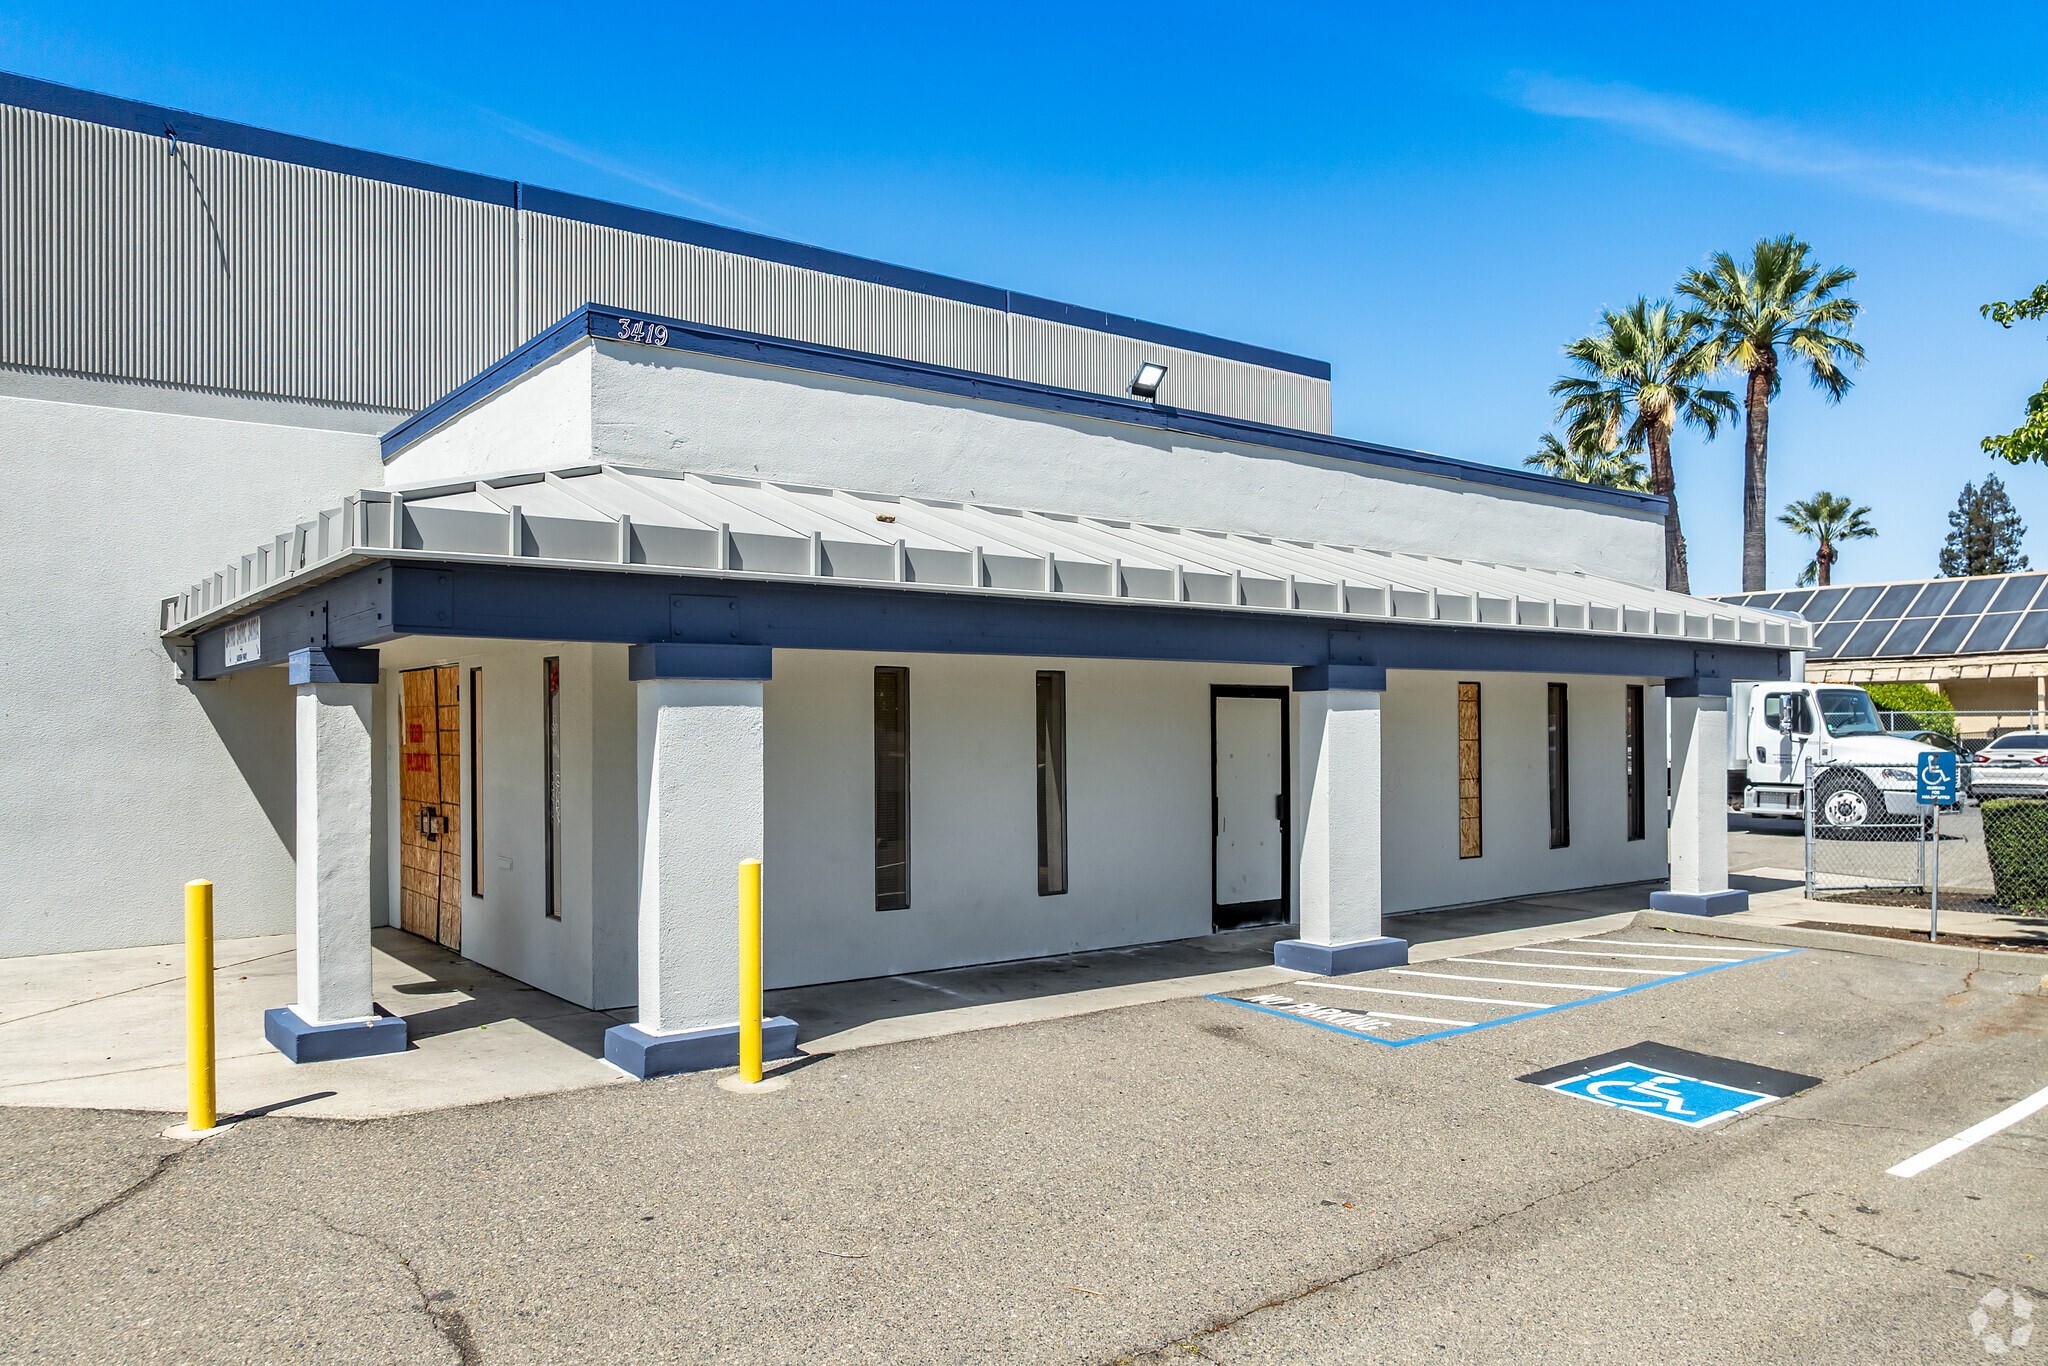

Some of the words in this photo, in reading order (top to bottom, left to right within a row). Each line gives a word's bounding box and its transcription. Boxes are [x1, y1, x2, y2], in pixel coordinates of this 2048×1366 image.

[617, 318, 669, 346] 3419
[1243, 993, 1295, 1005] NO
[1279, 1002, 1392, 1031] PARKING
